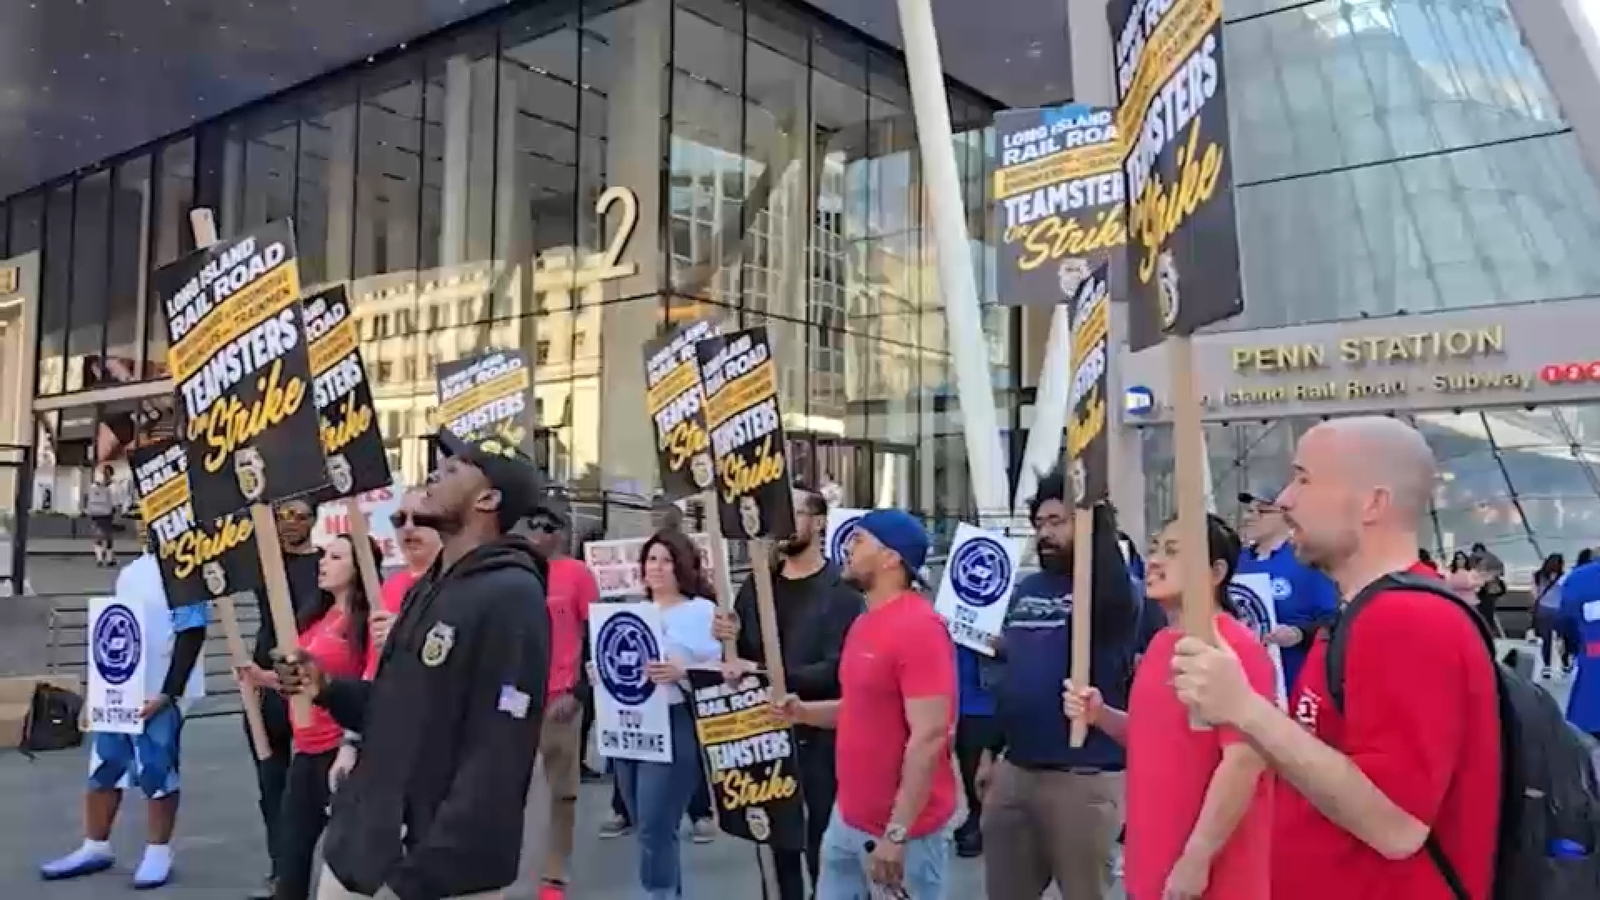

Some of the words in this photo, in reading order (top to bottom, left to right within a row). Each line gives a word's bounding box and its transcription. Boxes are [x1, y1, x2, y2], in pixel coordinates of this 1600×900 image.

[1003, 125, 1048, 148] LONG
[1051, 110, 1112, 135] ISLAND
[1003, 138, 1061, 166] RAIL
[1066, 125, 1119, 147] ROA
[1004, 171, 1124, 226] TEAMSTER
[595, 186, 637, 280] 2
[1018, 203, 1126, 270] Strik
[166, 277, 199, 317] LONG
[200, 236, 256, 288] ISLAND
[170, 291, 213, 341] RAIL
[213, 242, 286, 302] ROAD
[307, 302, 346, 342] OAD
[1232, 344, 1325, 371] PENN
[1339, 325, 1502, 363] STATION
[181, 308, 298, 418] TEAMSTERS
[313, 353, 363, 409] STERS
[725, 342, 767, 380] ROAD
[1297, 382, 1336, 400] Rail
[1347, 377, 1407, 398] Road
[1432, 370, 1534, 393] Subway
[204, 358, 306, 473] Strike
[139, 463, 176, 496] RAIL
[723, 434, 785, 504] Strike
[174, 512, 255, 579] Strike
[730, 686, 774, 711] ROA
[602, 730, 619, 750] ON
[622, 730, 665, 754] STRIKE
[723, 759, 798, 811] Strike
